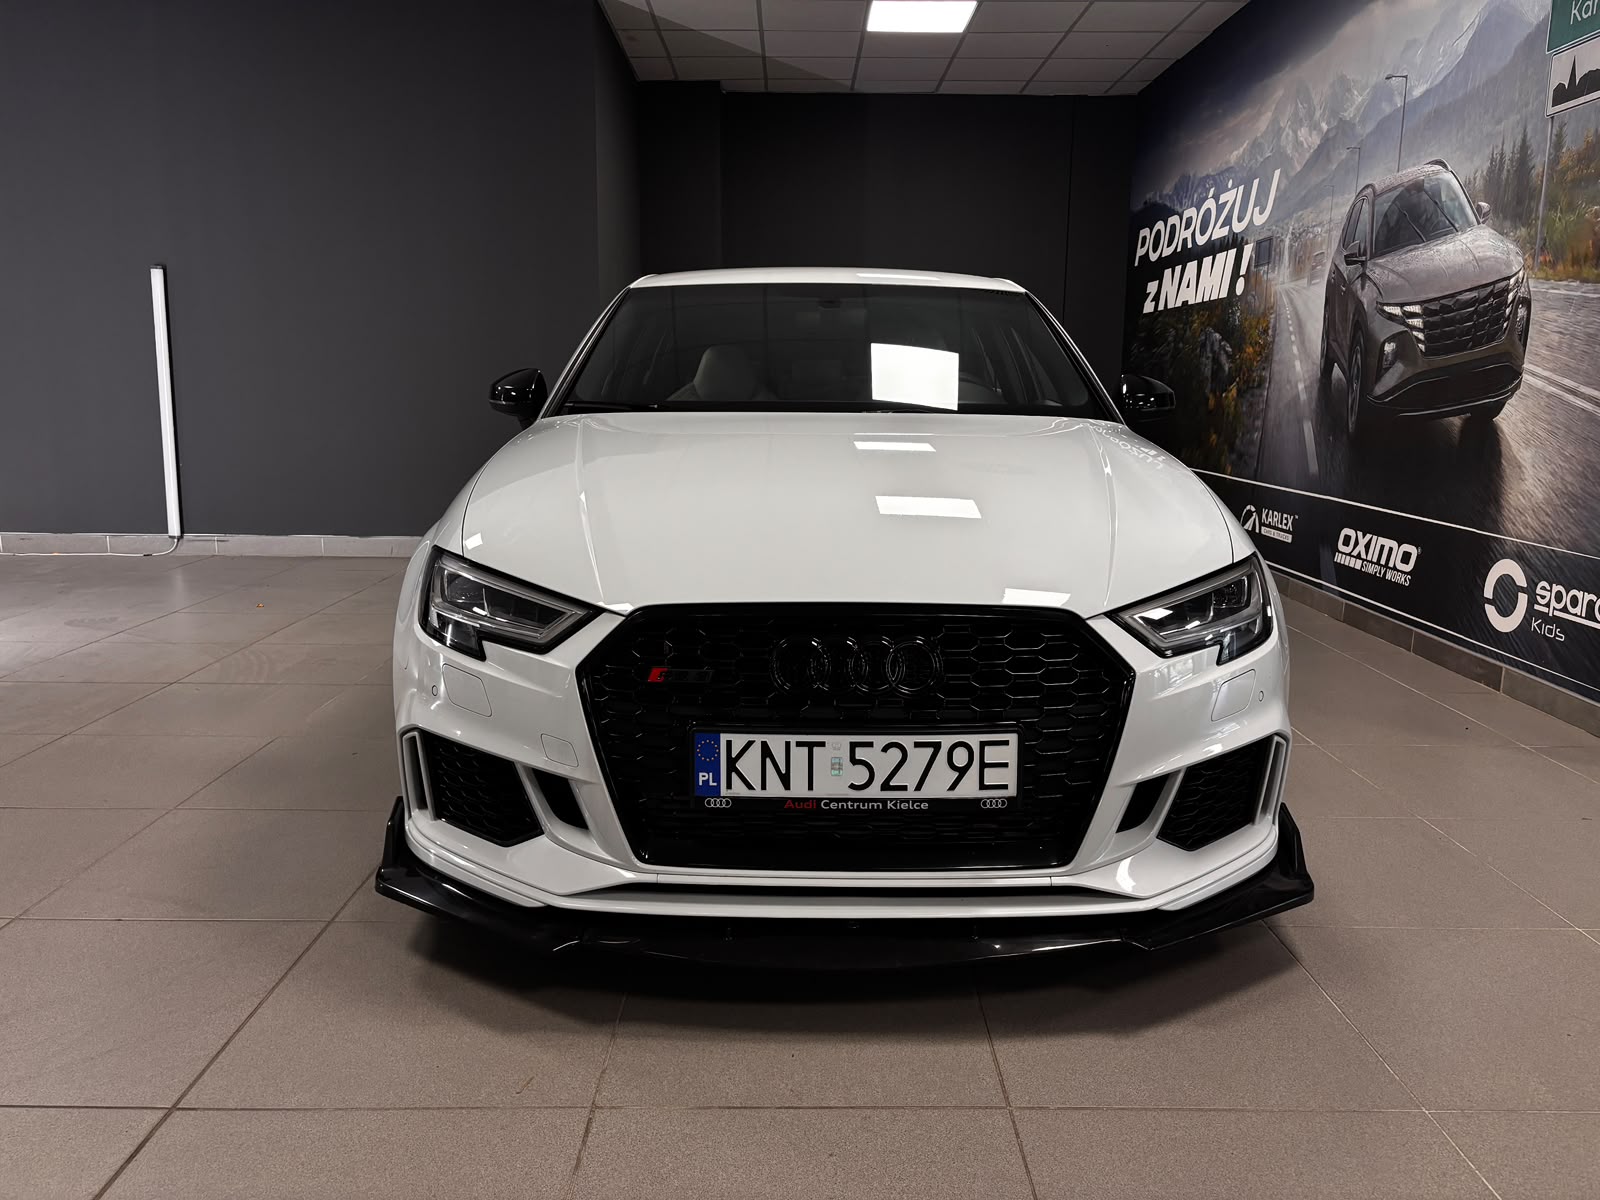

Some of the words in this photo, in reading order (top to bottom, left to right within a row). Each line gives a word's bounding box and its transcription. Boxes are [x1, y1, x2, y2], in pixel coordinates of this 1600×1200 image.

[1134, 168, 1281, 267] PODRÓŻUJ
[1261, 507, 1294, 532] KARLEX
[1337, 527, 1418, 573] OXIMO
[1361, 561, 1387, 578] SIMPLY
[1385, 568, 1412, 587] WORKS
[1531, 616, 1565, 642] Kids
[725, 739, 827, 792] KNT
[847, 739, 1010, 792] 5279E
[698, 772, 718, 786] PL
[784, 799, 817, 810] Audi
[820, 800, 883, 810] Centrum
[886, 799, 929, 811] Kielce
